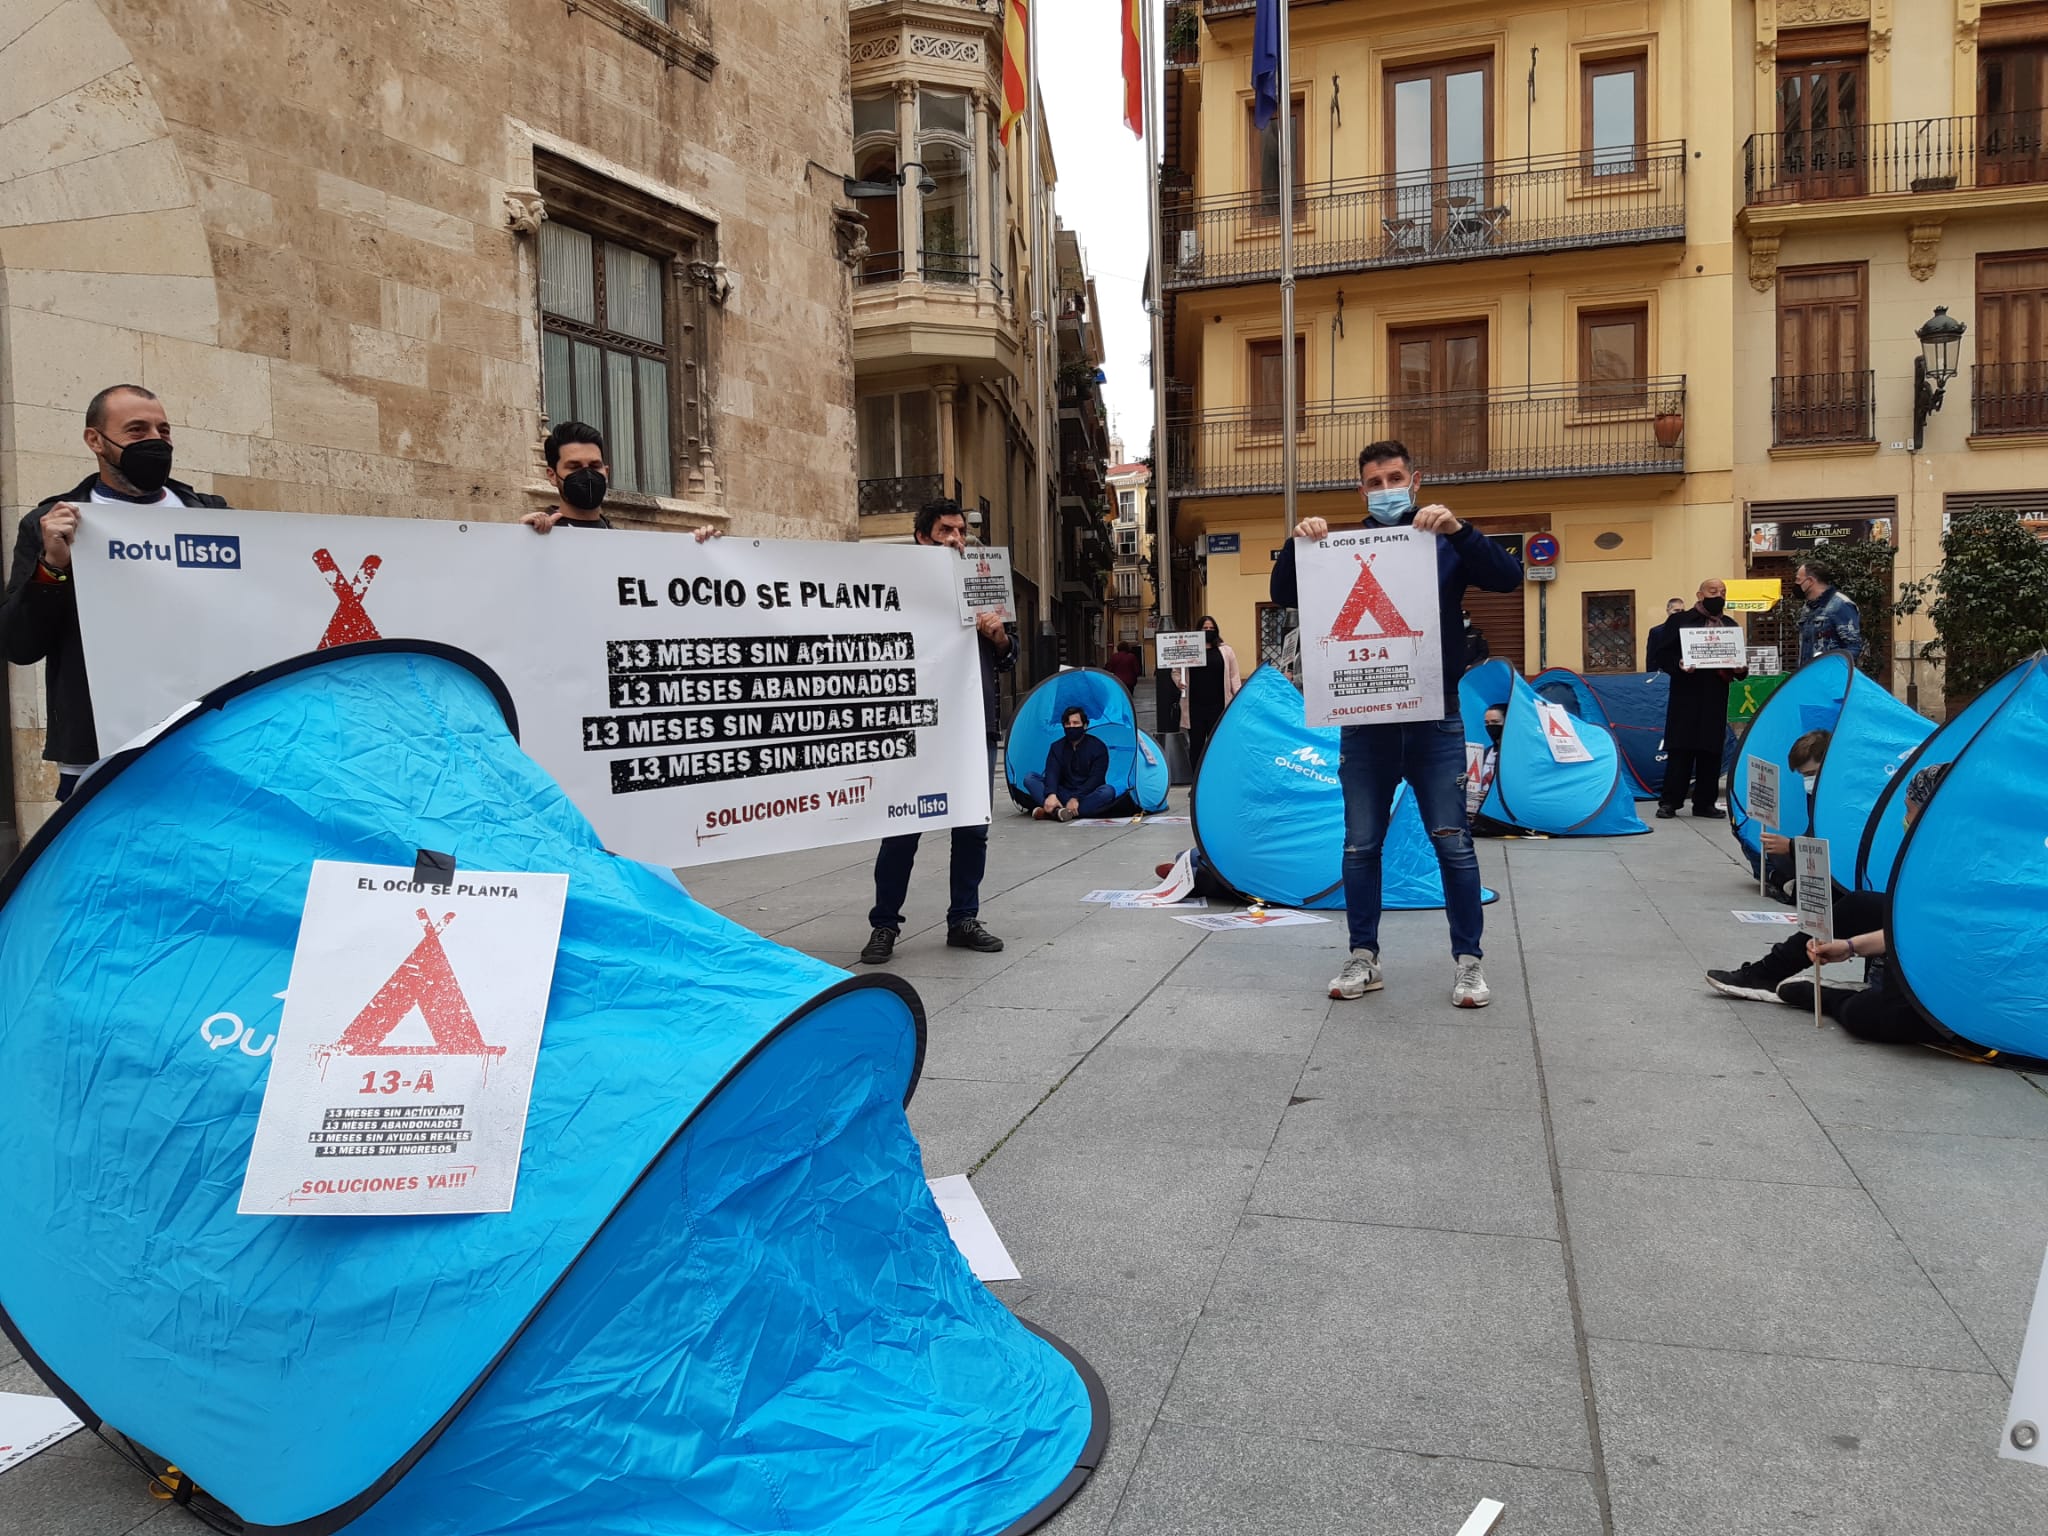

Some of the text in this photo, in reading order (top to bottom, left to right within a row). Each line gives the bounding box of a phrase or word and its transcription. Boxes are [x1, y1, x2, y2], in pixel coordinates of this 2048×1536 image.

[1320, 534, 1409, 549] EL OCIO SE PLANTA
[1792, 528, 1850, 537] ANILLO ATLANTE
[617, 576, 902, 612] EL OCIO SE PLANTA
[617, 640, 908, 669] 13 MESES SIN ACTIVIDAD
[1348, 646, 1390, 662] 13-A
[617, 673, 910, 706] 13 MESES ABANDONADOS
[1332, 700, 1418, 716] SOLUCIONES YA!!!
[586, 702, 934, 747] 13 MESES SIN AYUDAS REALES
[628, 737, 909, 782] 13 MESES SIN INGRESOS
[1274, 756, 1337, 785] Quechua
[706, 785, 866, 829] SOLUCIONES YA!!!
[357, 877, 519, 899] EL OCIO SE PLANTA
[358, 1069, 436, 1095] 13-A
[328, 1106, 462, 1118] 13 MESES SIN ACTIVIDAD
[325, 1119, 459, 1130] 13 MESES ABANDONADOS
[309, 1131, 470, 1142] 13 MESES SIN AYUDAS REALES
[322, 1144, 452, 1155] 13 MESES SIN INGRESOS
[301, 1172, 468, 1195] SOLUCIONES YA!!!
[25, 1431, 61, 1450] OCIO
